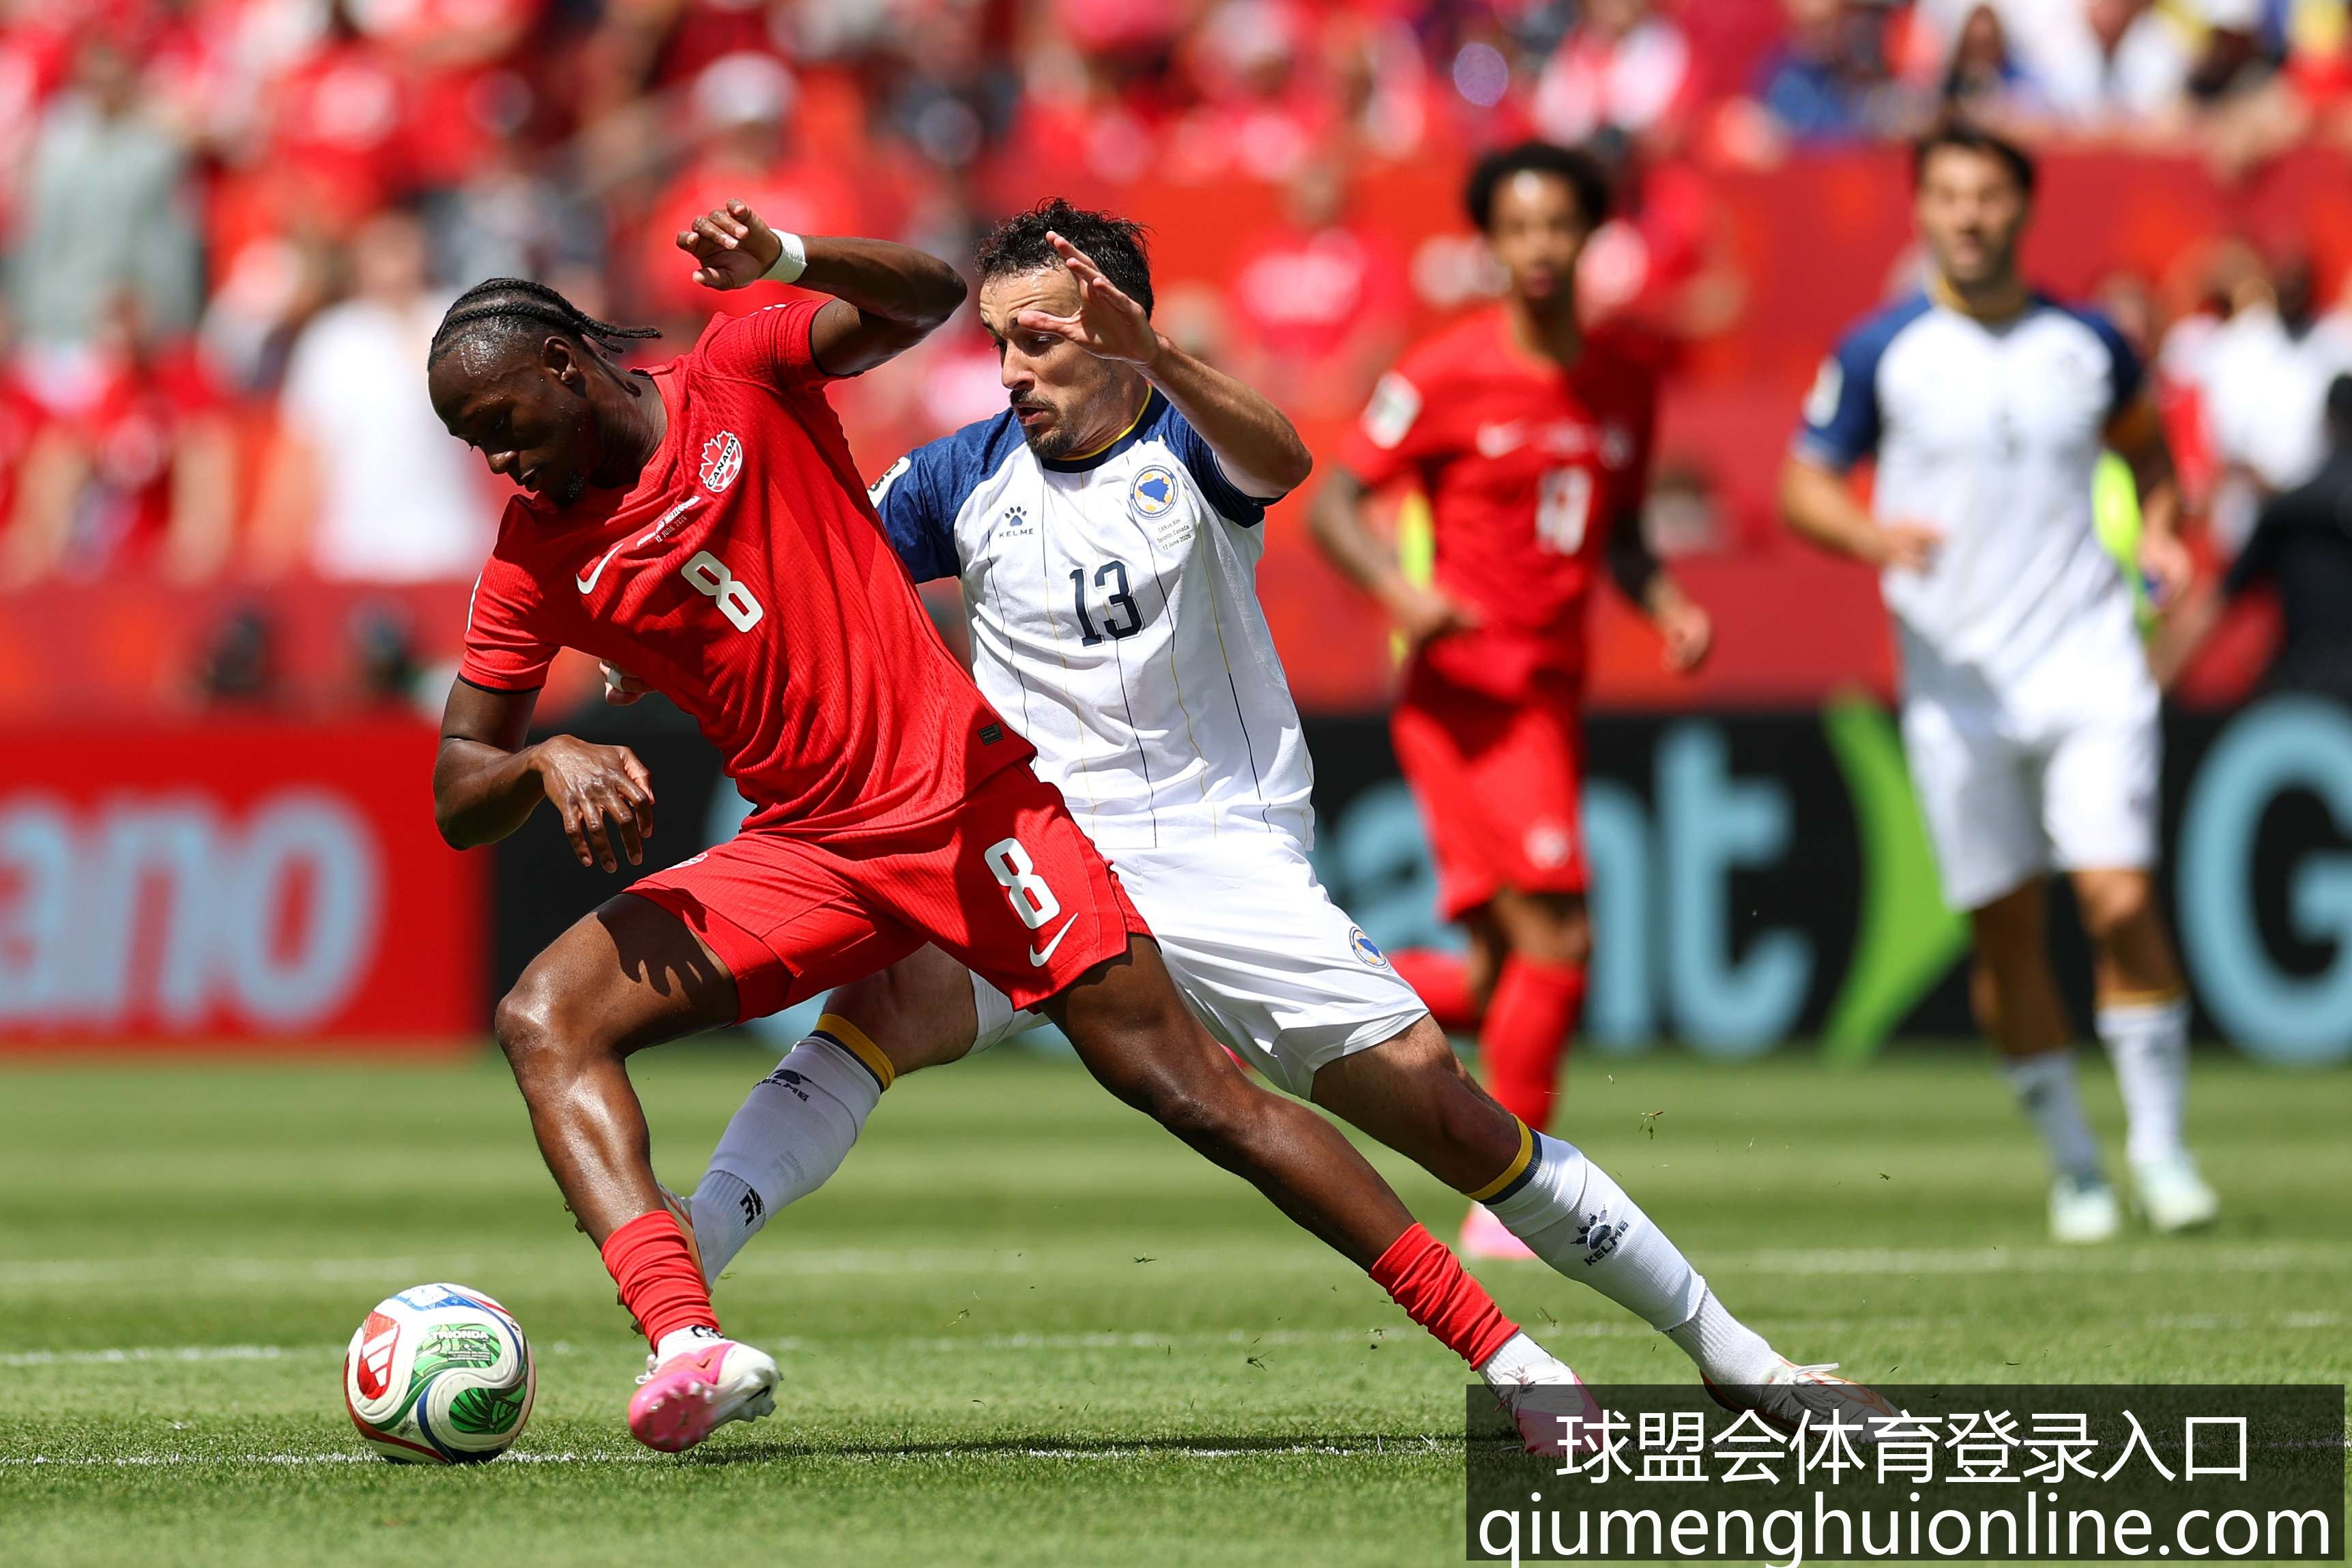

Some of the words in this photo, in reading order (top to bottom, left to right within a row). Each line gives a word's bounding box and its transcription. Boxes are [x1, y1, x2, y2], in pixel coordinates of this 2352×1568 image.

[708, 438, 736, 487] CANADA
[999, 528, 1034, 538] KELME
[682, 551, 763, 633] 8
[1069, 560, 1148, 648] 13
[984, 837, 1061, 929] 8
[1584, 1220, 1629, 1266] KELME
[431, 1331, 489, 1339] TRIONDA
